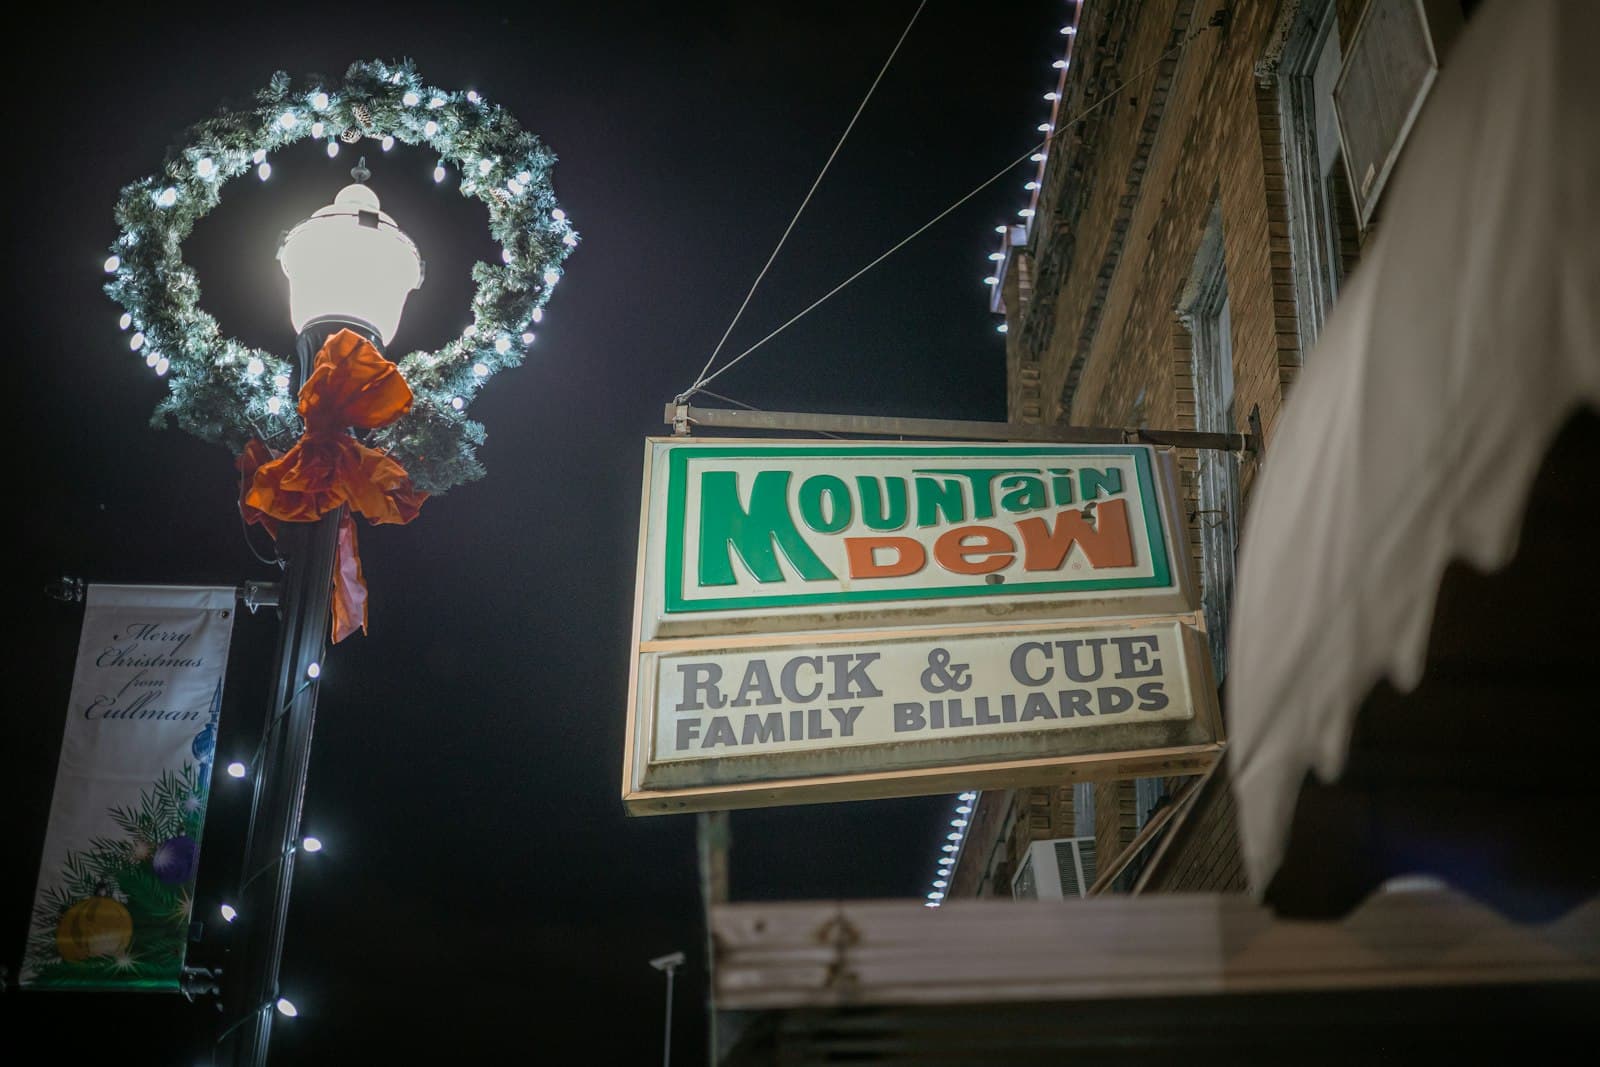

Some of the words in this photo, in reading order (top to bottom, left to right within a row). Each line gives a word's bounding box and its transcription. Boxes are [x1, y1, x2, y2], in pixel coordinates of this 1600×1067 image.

[95, 643, 204, 668] Christmas
[113, 623, 193, 657] Merry
[116, 669, 165, 698] from
[675, 651, 883, 712] RACK
[920, 647, 972, 694] &
[1010, 634, 1163, 687] CUE
[84, 690, 201, 721] Cullman
[675, 705, 864, 751] FAMILY
[893, 682, 1170, 733] BILLIARDS
